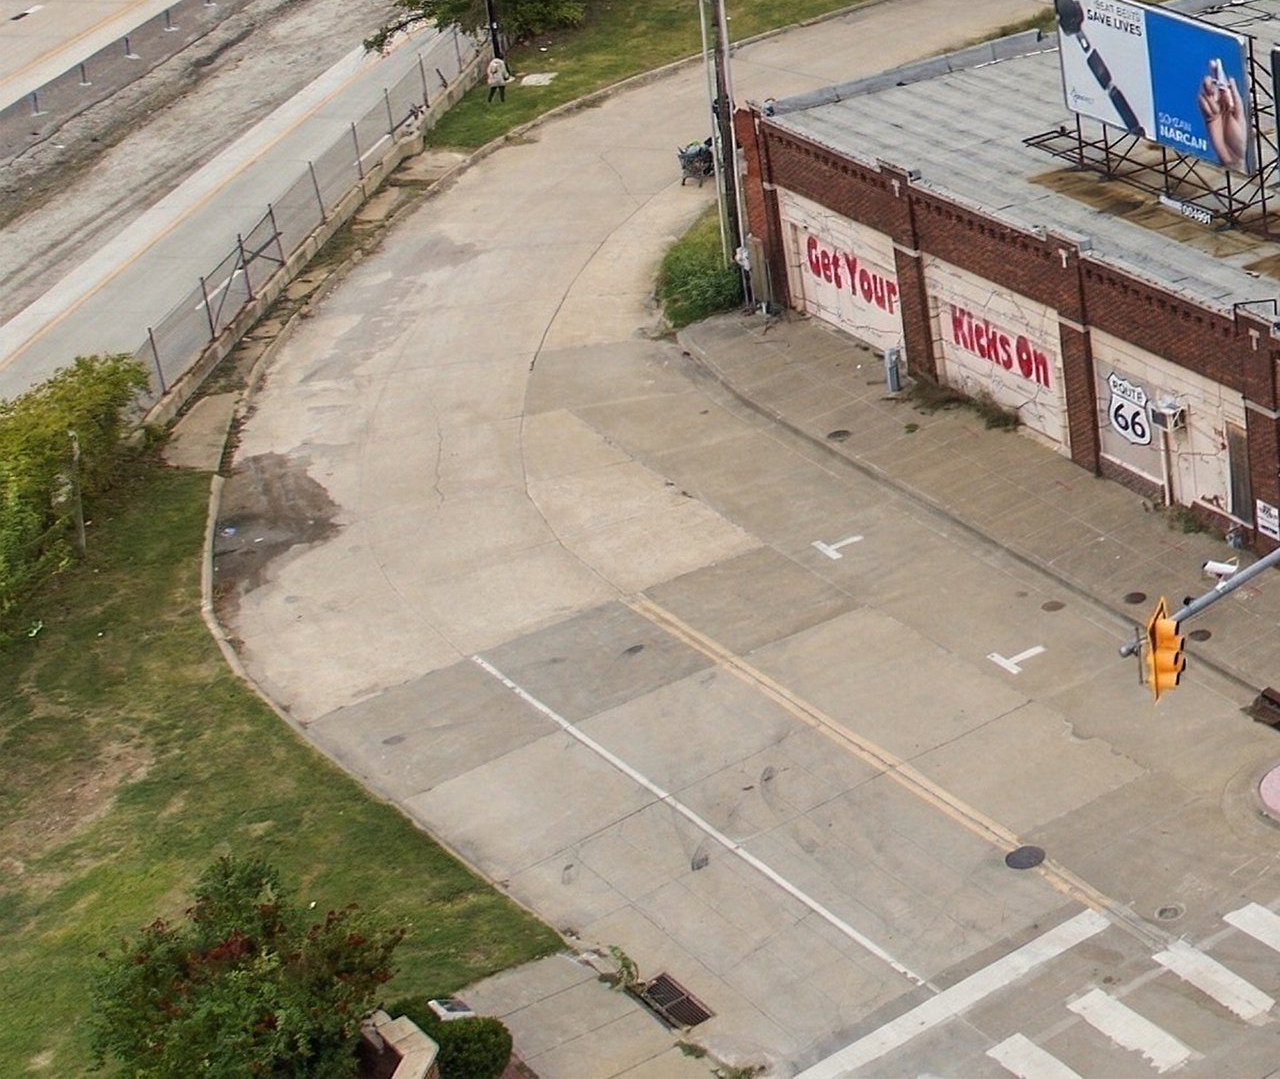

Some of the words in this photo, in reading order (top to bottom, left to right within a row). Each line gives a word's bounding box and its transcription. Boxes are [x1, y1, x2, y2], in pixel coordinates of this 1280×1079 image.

[1095, 0, 1114, 15] SEAT
[1087, 9, 1112, 28] SAVE
[1113, 19, 1142, 37] LIVES
[1160, 125, 1208, 151] NARCAN
[806, 235, 842, 290] Get
[843, 252, 900, 315] Your
[950, 303, 1014, 371] Kicks
[1016, 335, 1050, 389] On
[1112, 380, 1143, 402] ROUTE
[1114, 404, 1146, 440] 66
